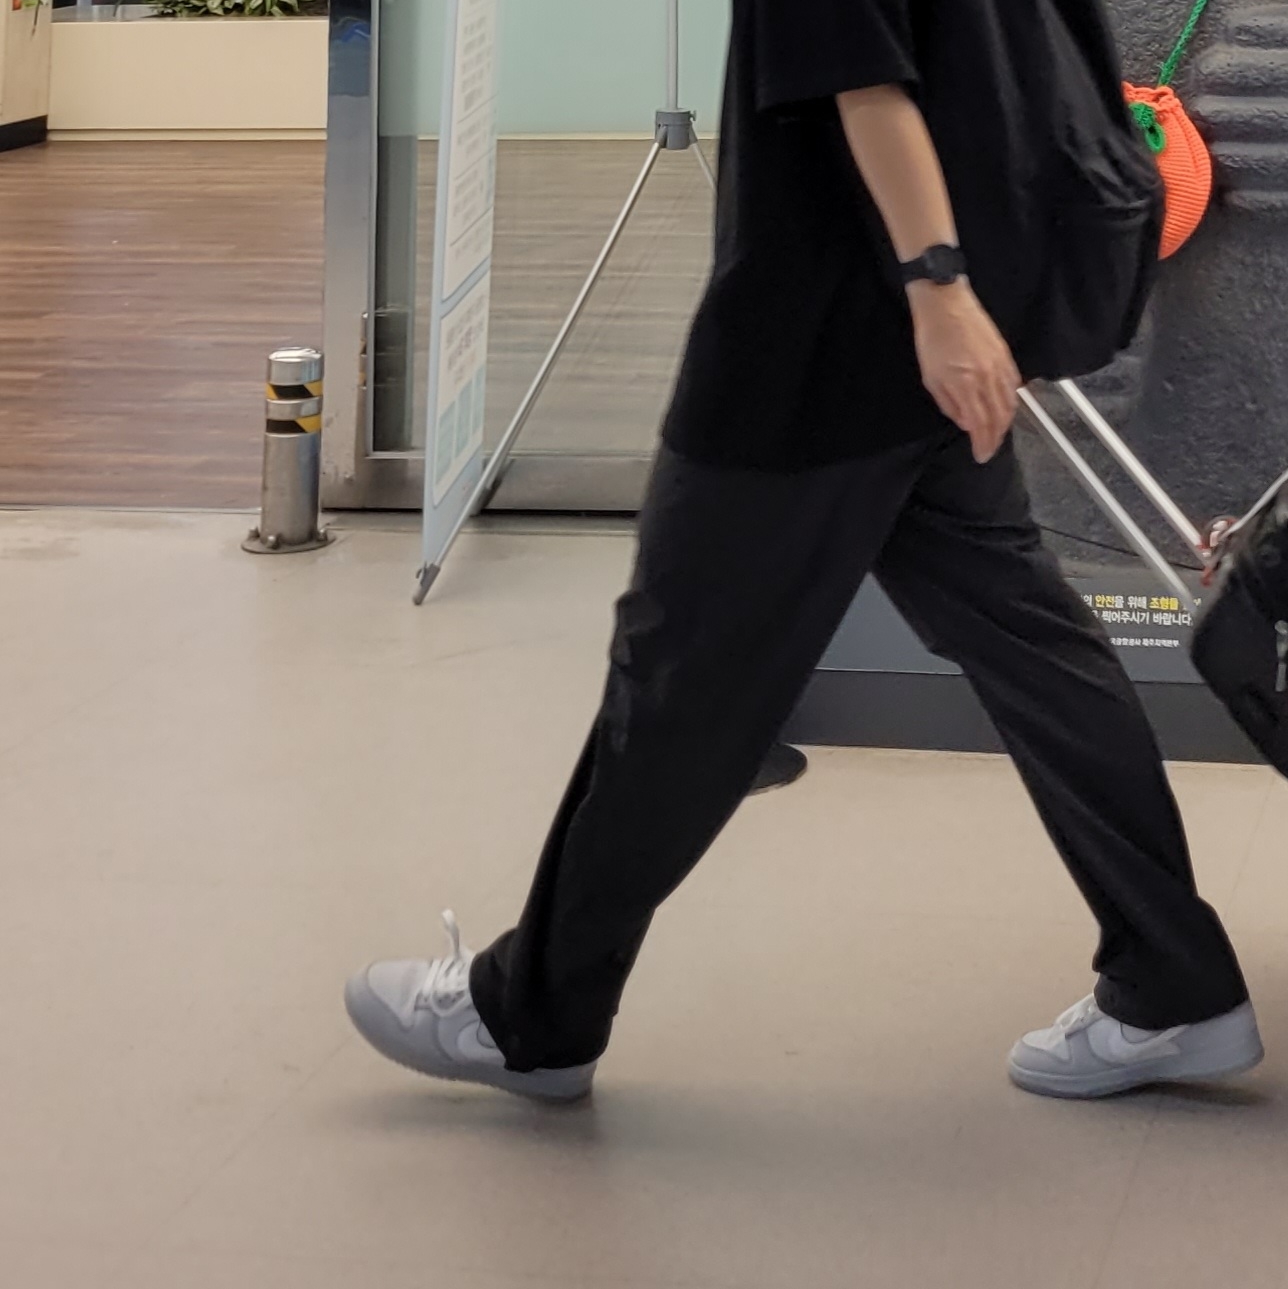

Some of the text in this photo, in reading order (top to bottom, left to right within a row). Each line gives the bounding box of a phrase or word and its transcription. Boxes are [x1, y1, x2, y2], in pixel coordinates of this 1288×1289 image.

[1095, 594, 1124, 609] 안전을
[1127, 596, 1147, 609] 위해
[1101, 611, 1150, 624] 찍어주시기
